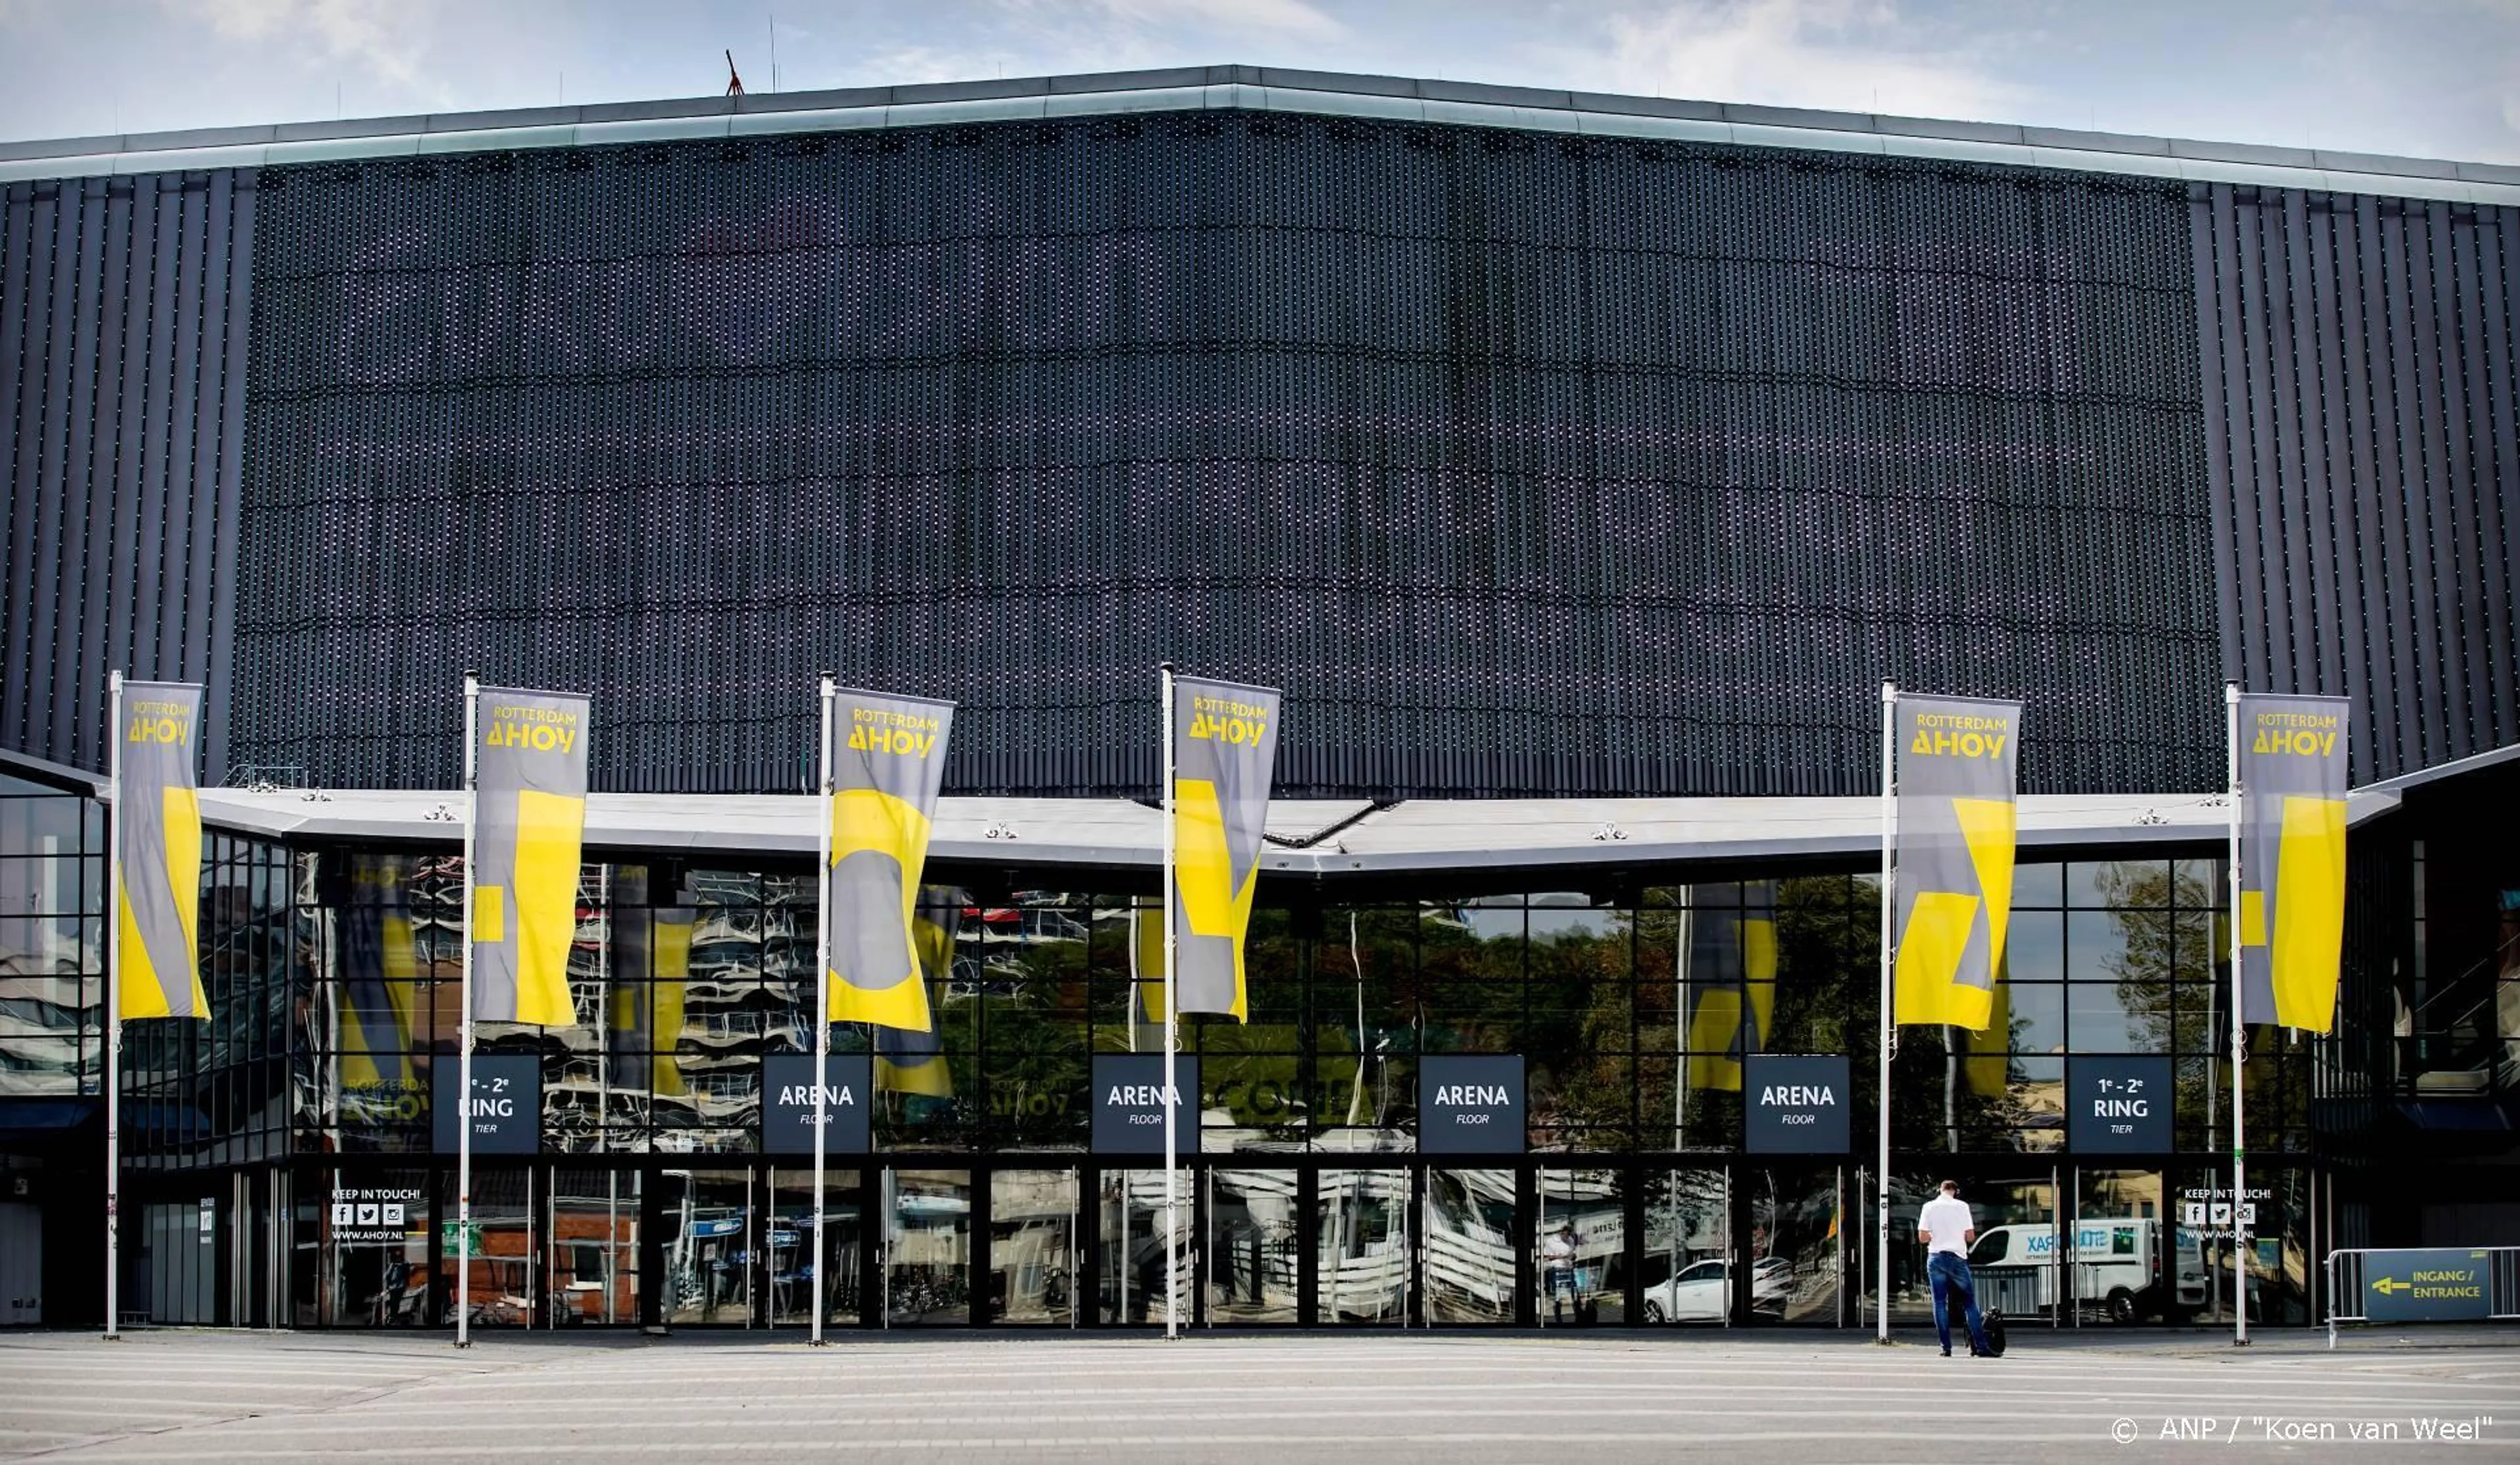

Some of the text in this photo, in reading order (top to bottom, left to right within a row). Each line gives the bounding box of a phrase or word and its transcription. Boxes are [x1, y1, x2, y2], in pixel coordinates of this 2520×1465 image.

[134, 701, 190, 717] ROTTERDAM
[494, 706, 577, 726] ROTTERDAM
[1194, 696, 1268, 720] ROTTERDAM
[854, 708, 939, 732] ROTTERDAM
[1917, 713, 2007, 732] ROTTERDAM
[2257, 713, 2337, 728] ROTTERDAM
[129, 717, 188, 746] AHOY
[487, 721, 576, 754] AHOY
[1189, 713, 1266, 747] AHOY
[848, 724, 936, 758] AHOY
[1910, 729, 2006, 759] AHOY
[2252, 729, 2336, 757] AHOY
[778, 1085, 854, 1105] ARENA
[1107, 1085, 1183, 1105] ARENA
[1435, 1085, 1509, 1105] ARENA
[1760, 1085, 1836, 1105] ARENA
[2094, 1099, 2148, 1117] RING
[800, 1115, 833, 1124] FLOR
[1129, 1115, 1163, 1124] FLOOR
[1456, 1115, 1490, 1124] FLOOR
[1782, 1115, 1815, 1124] FLOOR
[475, 1124, 497, 1134] TIER
[2110, 1124, 2133, 1134] TIER
[332, 1189, 420, 1200] KEEP IN TOUCH!
[2185, 1189, 2271, 1199] KEEP IN TUCH!
[331, 1231, 404, 1240] WWW.AHOY.NL
[2413, 1270, 2466, 1283] INGANG
[2413, 1286, 2480, 1298] ENTRANCE
